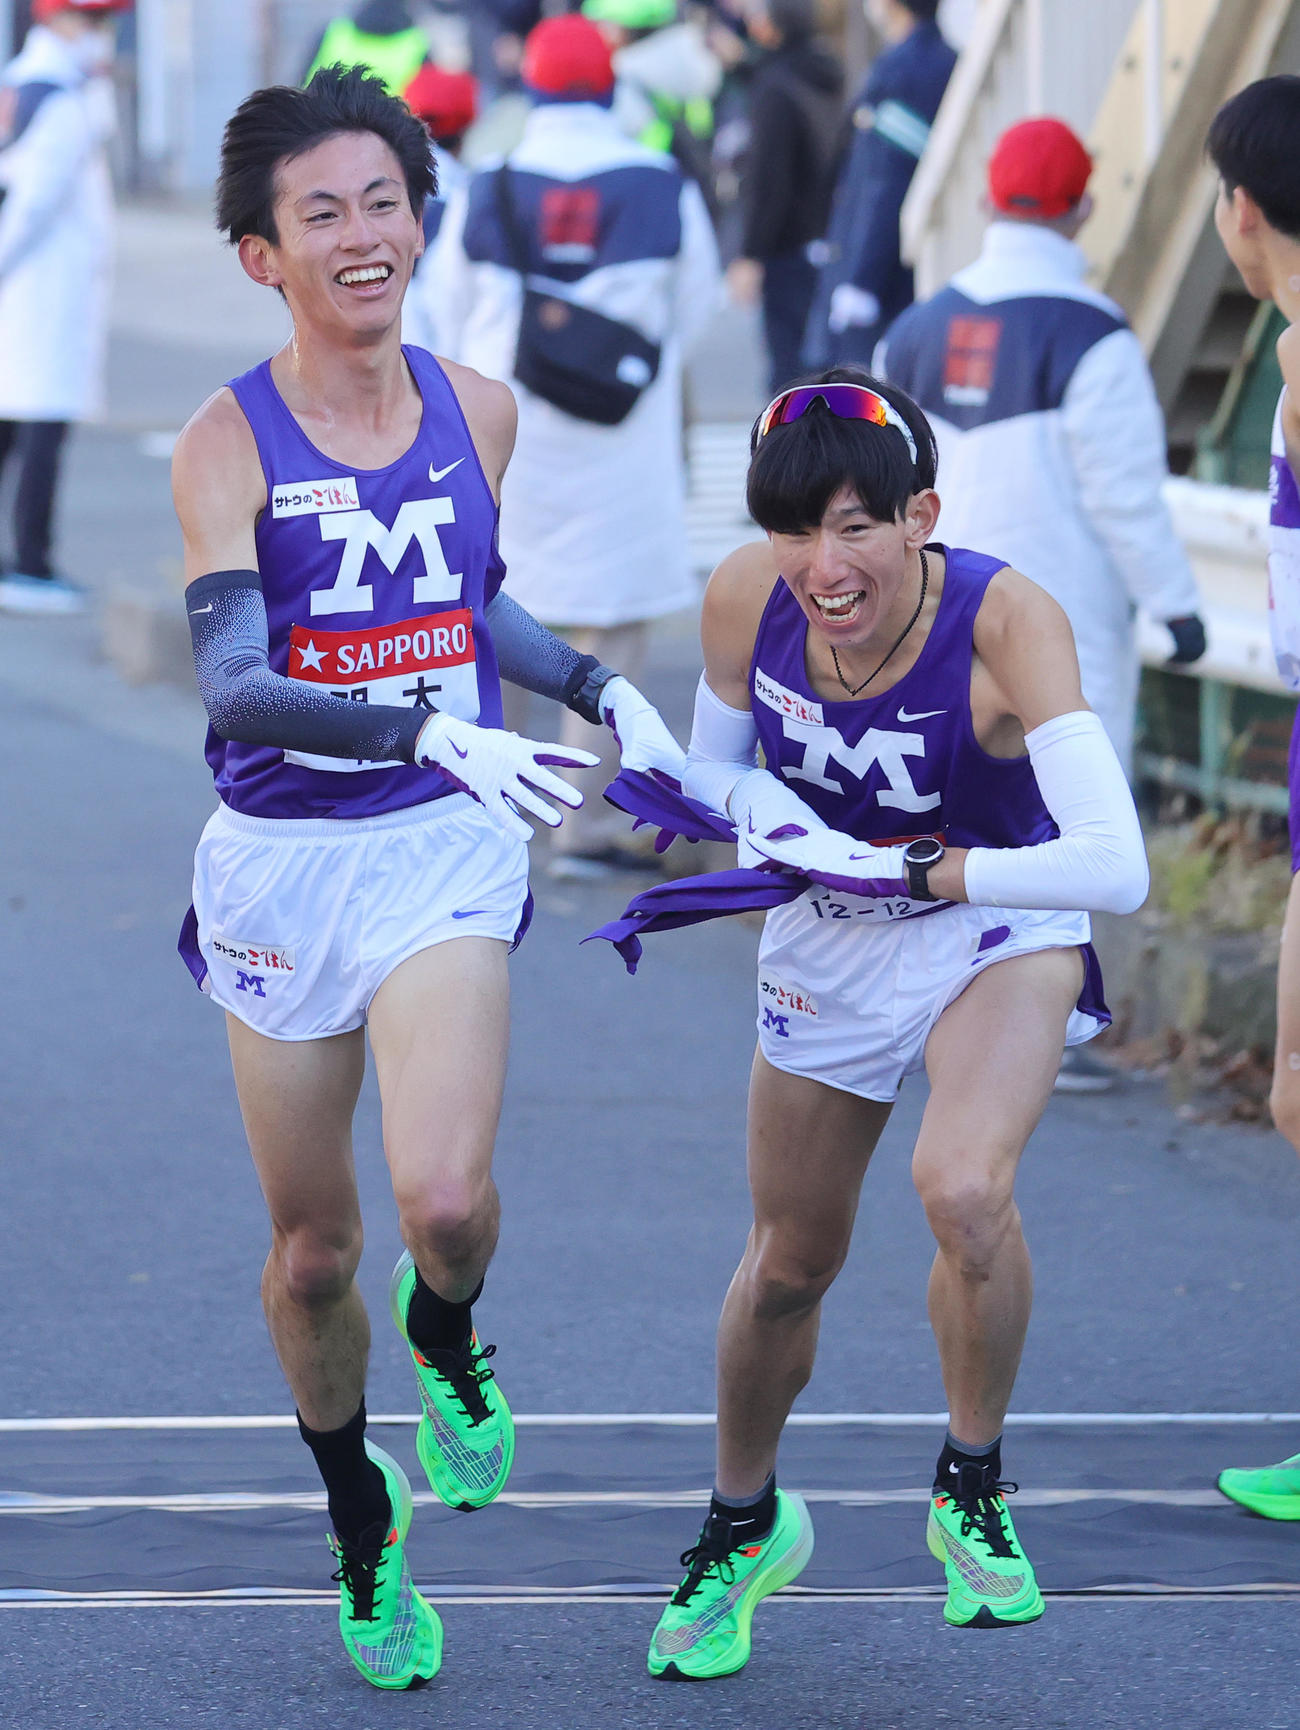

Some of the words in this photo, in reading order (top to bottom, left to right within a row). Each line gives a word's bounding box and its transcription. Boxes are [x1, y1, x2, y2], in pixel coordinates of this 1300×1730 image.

[310, 497, 464, 616] M
[337, 624, 467, 674] SAPPORO
[781, 717, 942, 814] M
[235, 970, 266, 998] M
[762, 1006, 789, 1037] M
